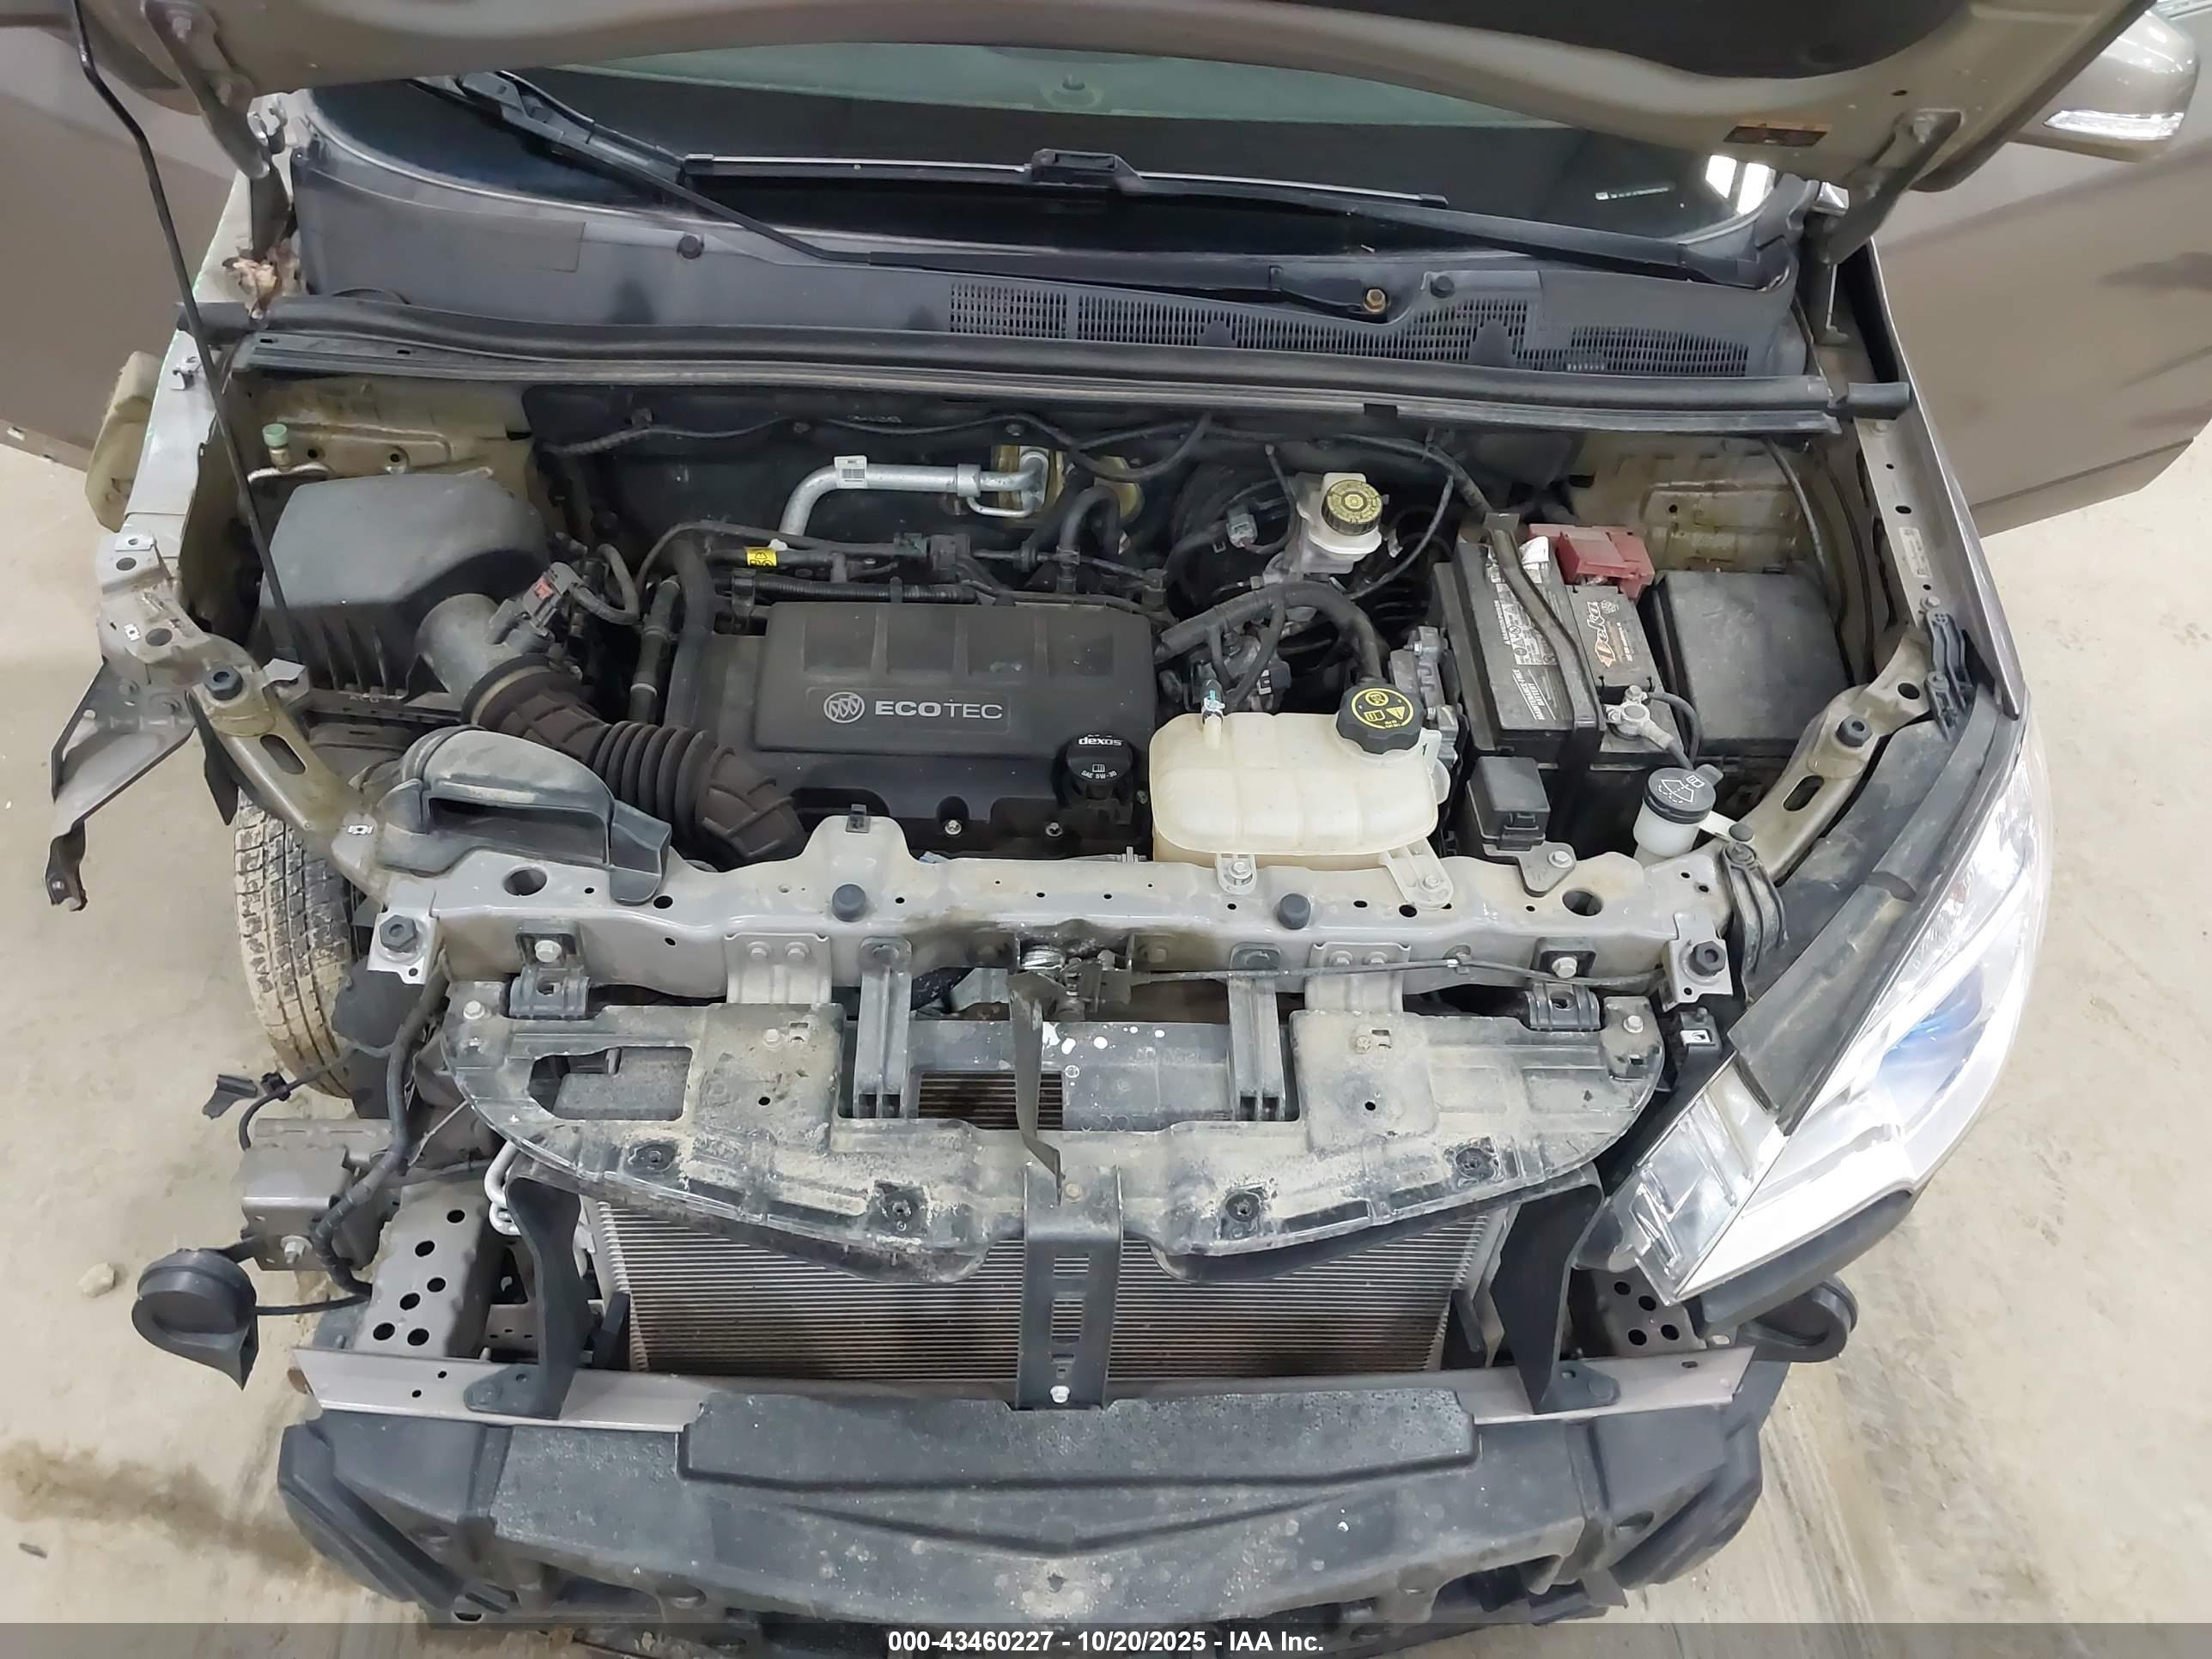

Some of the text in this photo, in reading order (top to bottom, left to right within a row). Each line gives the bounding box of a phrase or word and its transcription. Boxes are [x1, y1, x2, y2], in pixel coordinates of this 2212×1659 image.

[1586, 601, 1616, 667] Deka
[875, 700, 1003, 719] ECOTEC
[1078, 736, 1123, 746] dexos
[1081, 769, 1118, 780] SAE 5W-30
